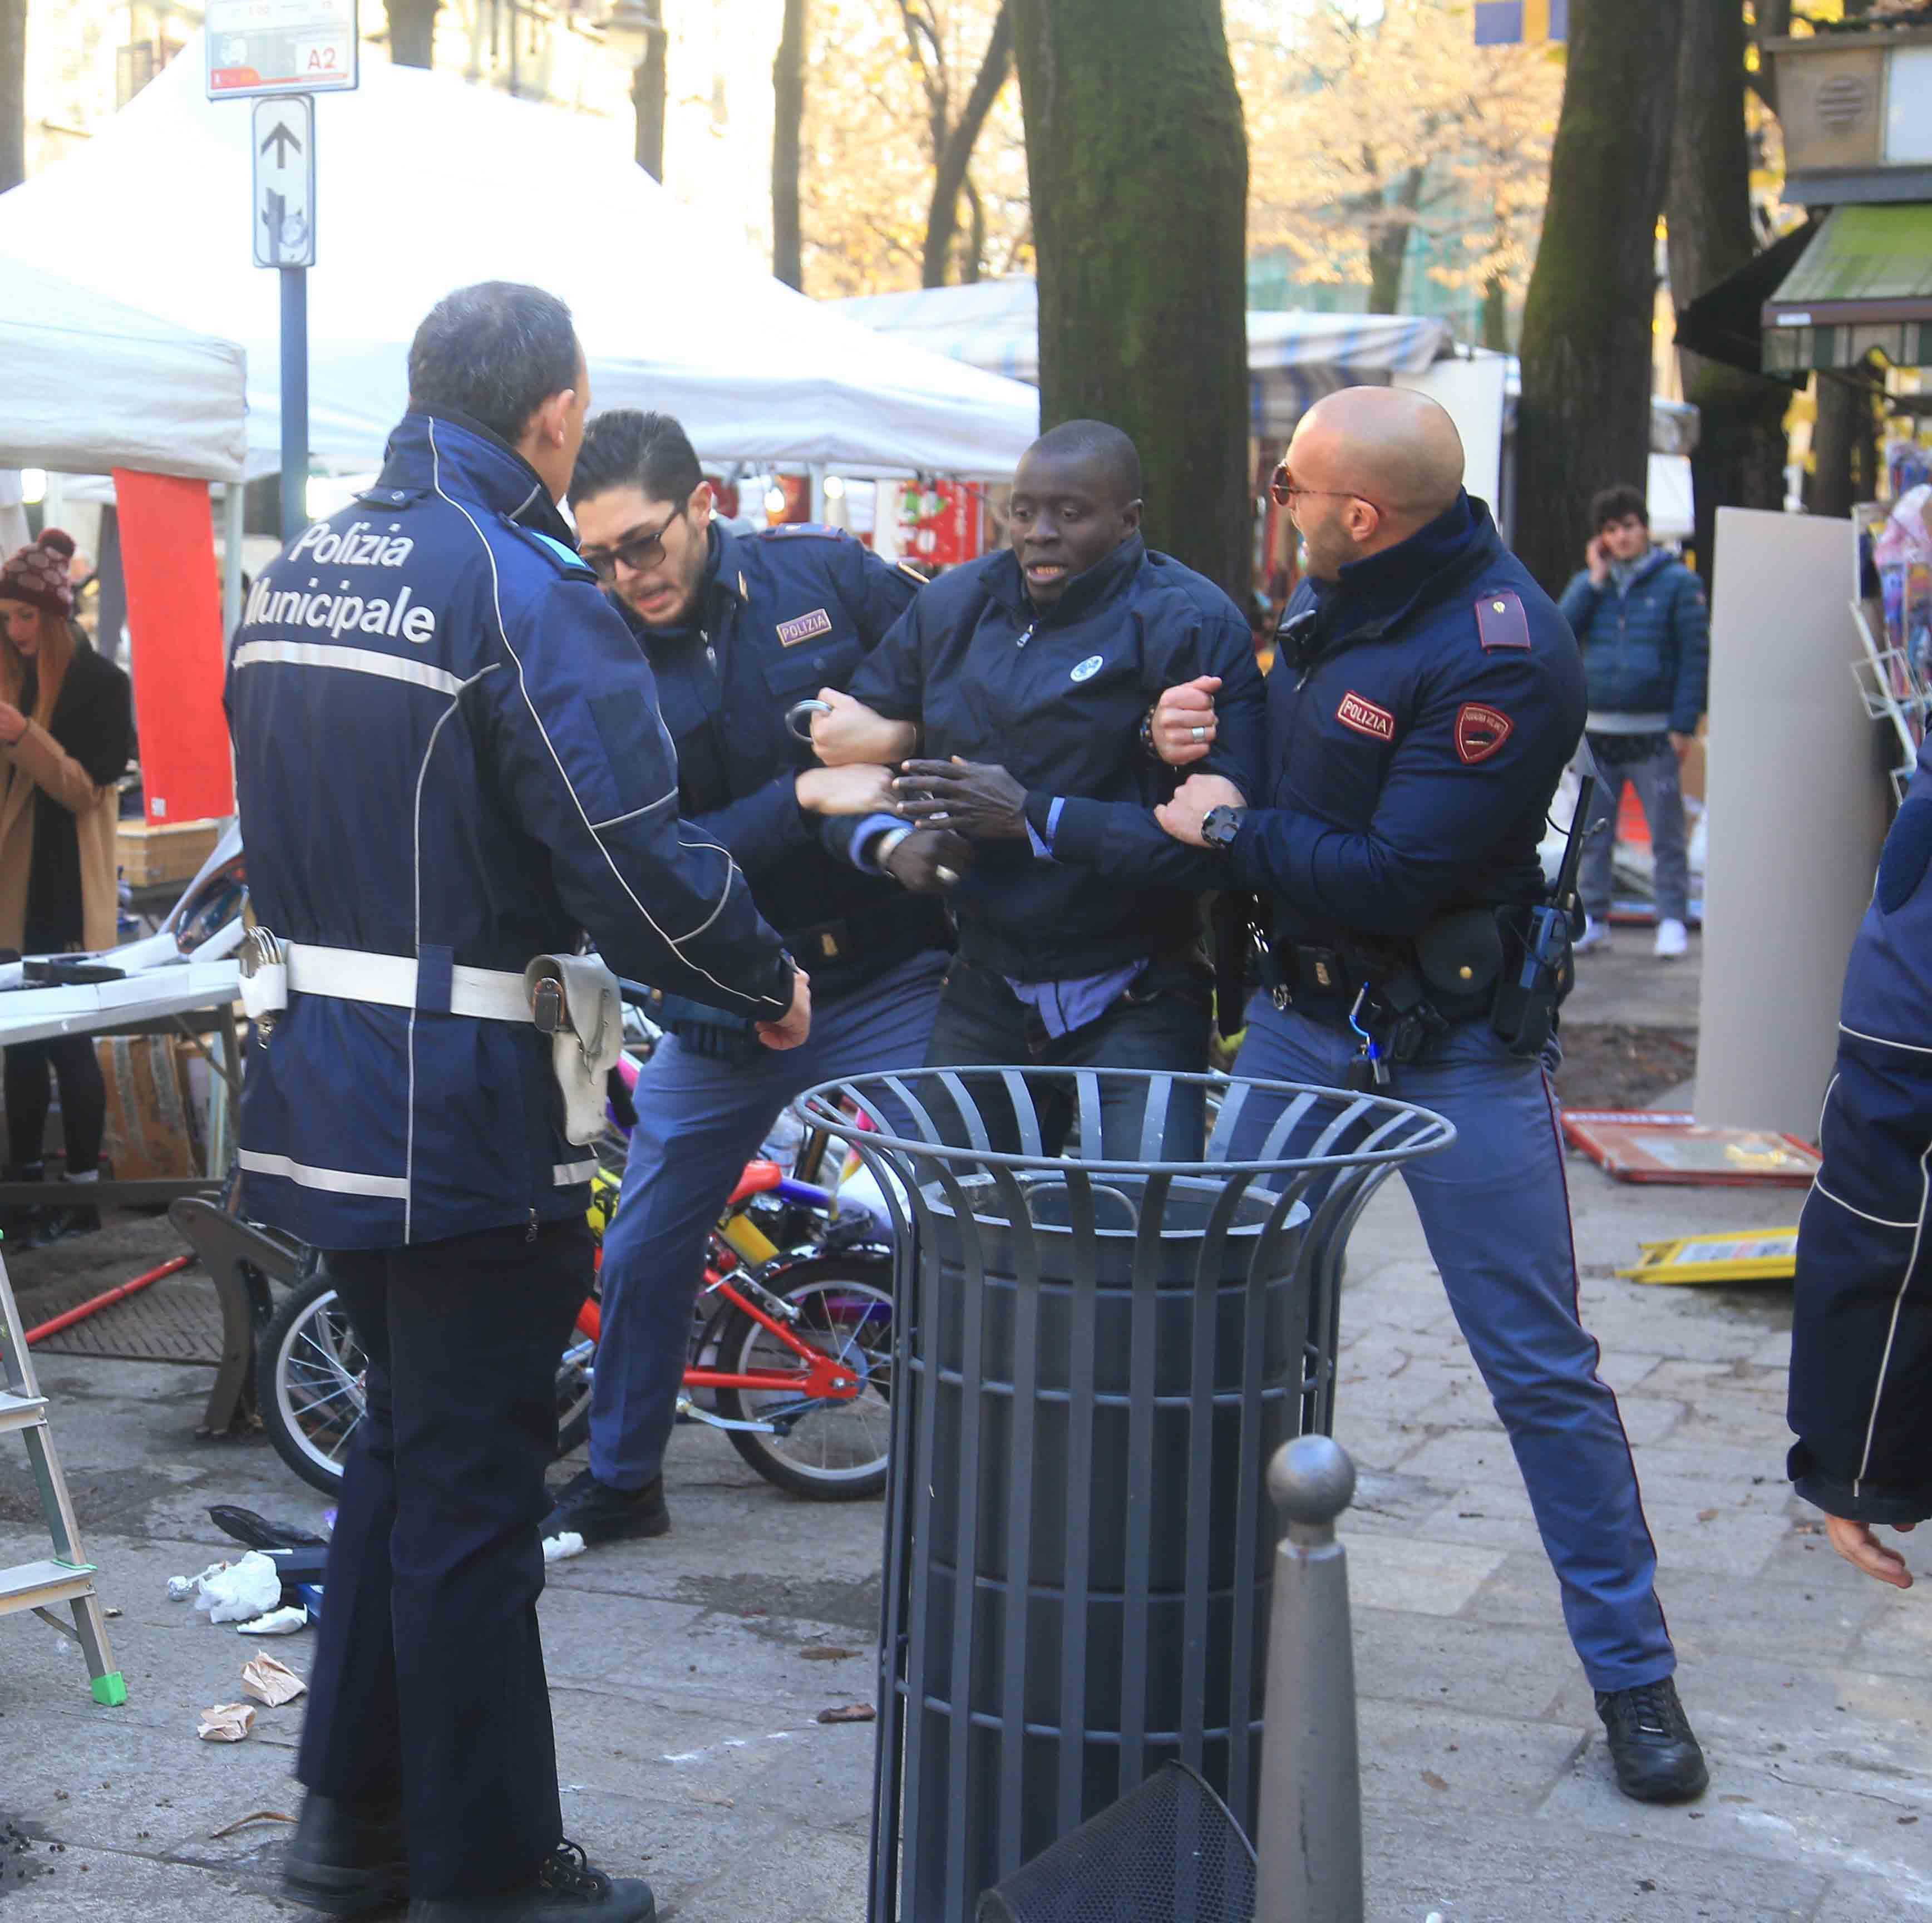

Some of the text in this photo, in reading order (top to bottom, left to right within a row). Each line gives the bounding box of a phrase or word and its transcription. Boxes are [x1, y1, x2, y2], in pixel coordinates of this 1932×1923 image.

[308, 47, 337, 70] A2
[288, 521, 414, 568] Polizia
[782, 614, 827, 642] POLIZIA
[1342, 700, 1387, 733] POLIZIA
